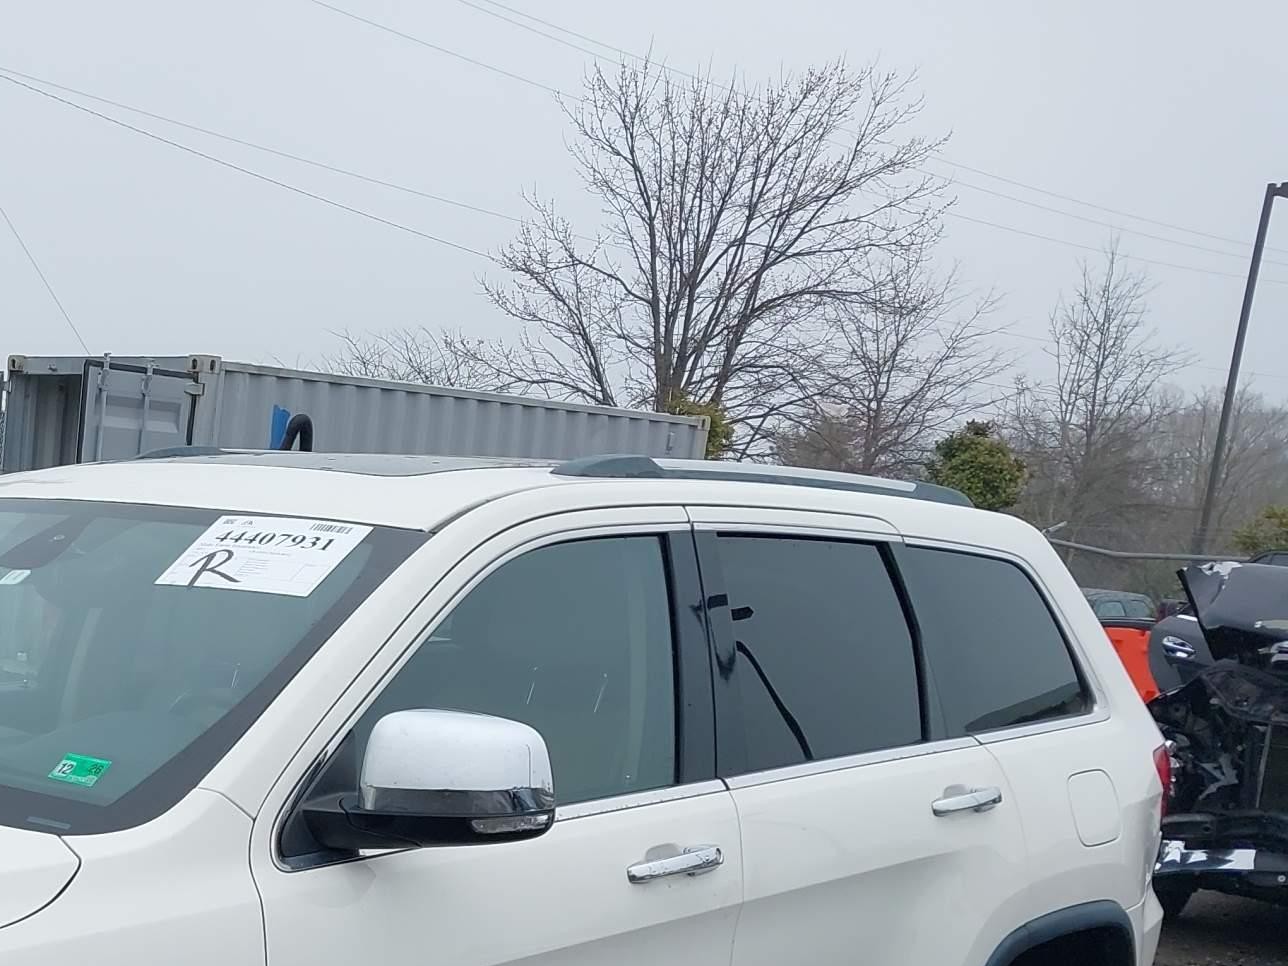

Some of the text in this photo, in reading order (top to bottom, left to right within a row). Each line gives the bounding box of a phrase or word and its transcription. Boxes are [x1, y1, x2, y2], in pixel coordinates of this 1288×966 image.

[215, 530, 335, 551] 44407931
[188, 549, 241, 590] R
[57, 762, 74, 775] 12
